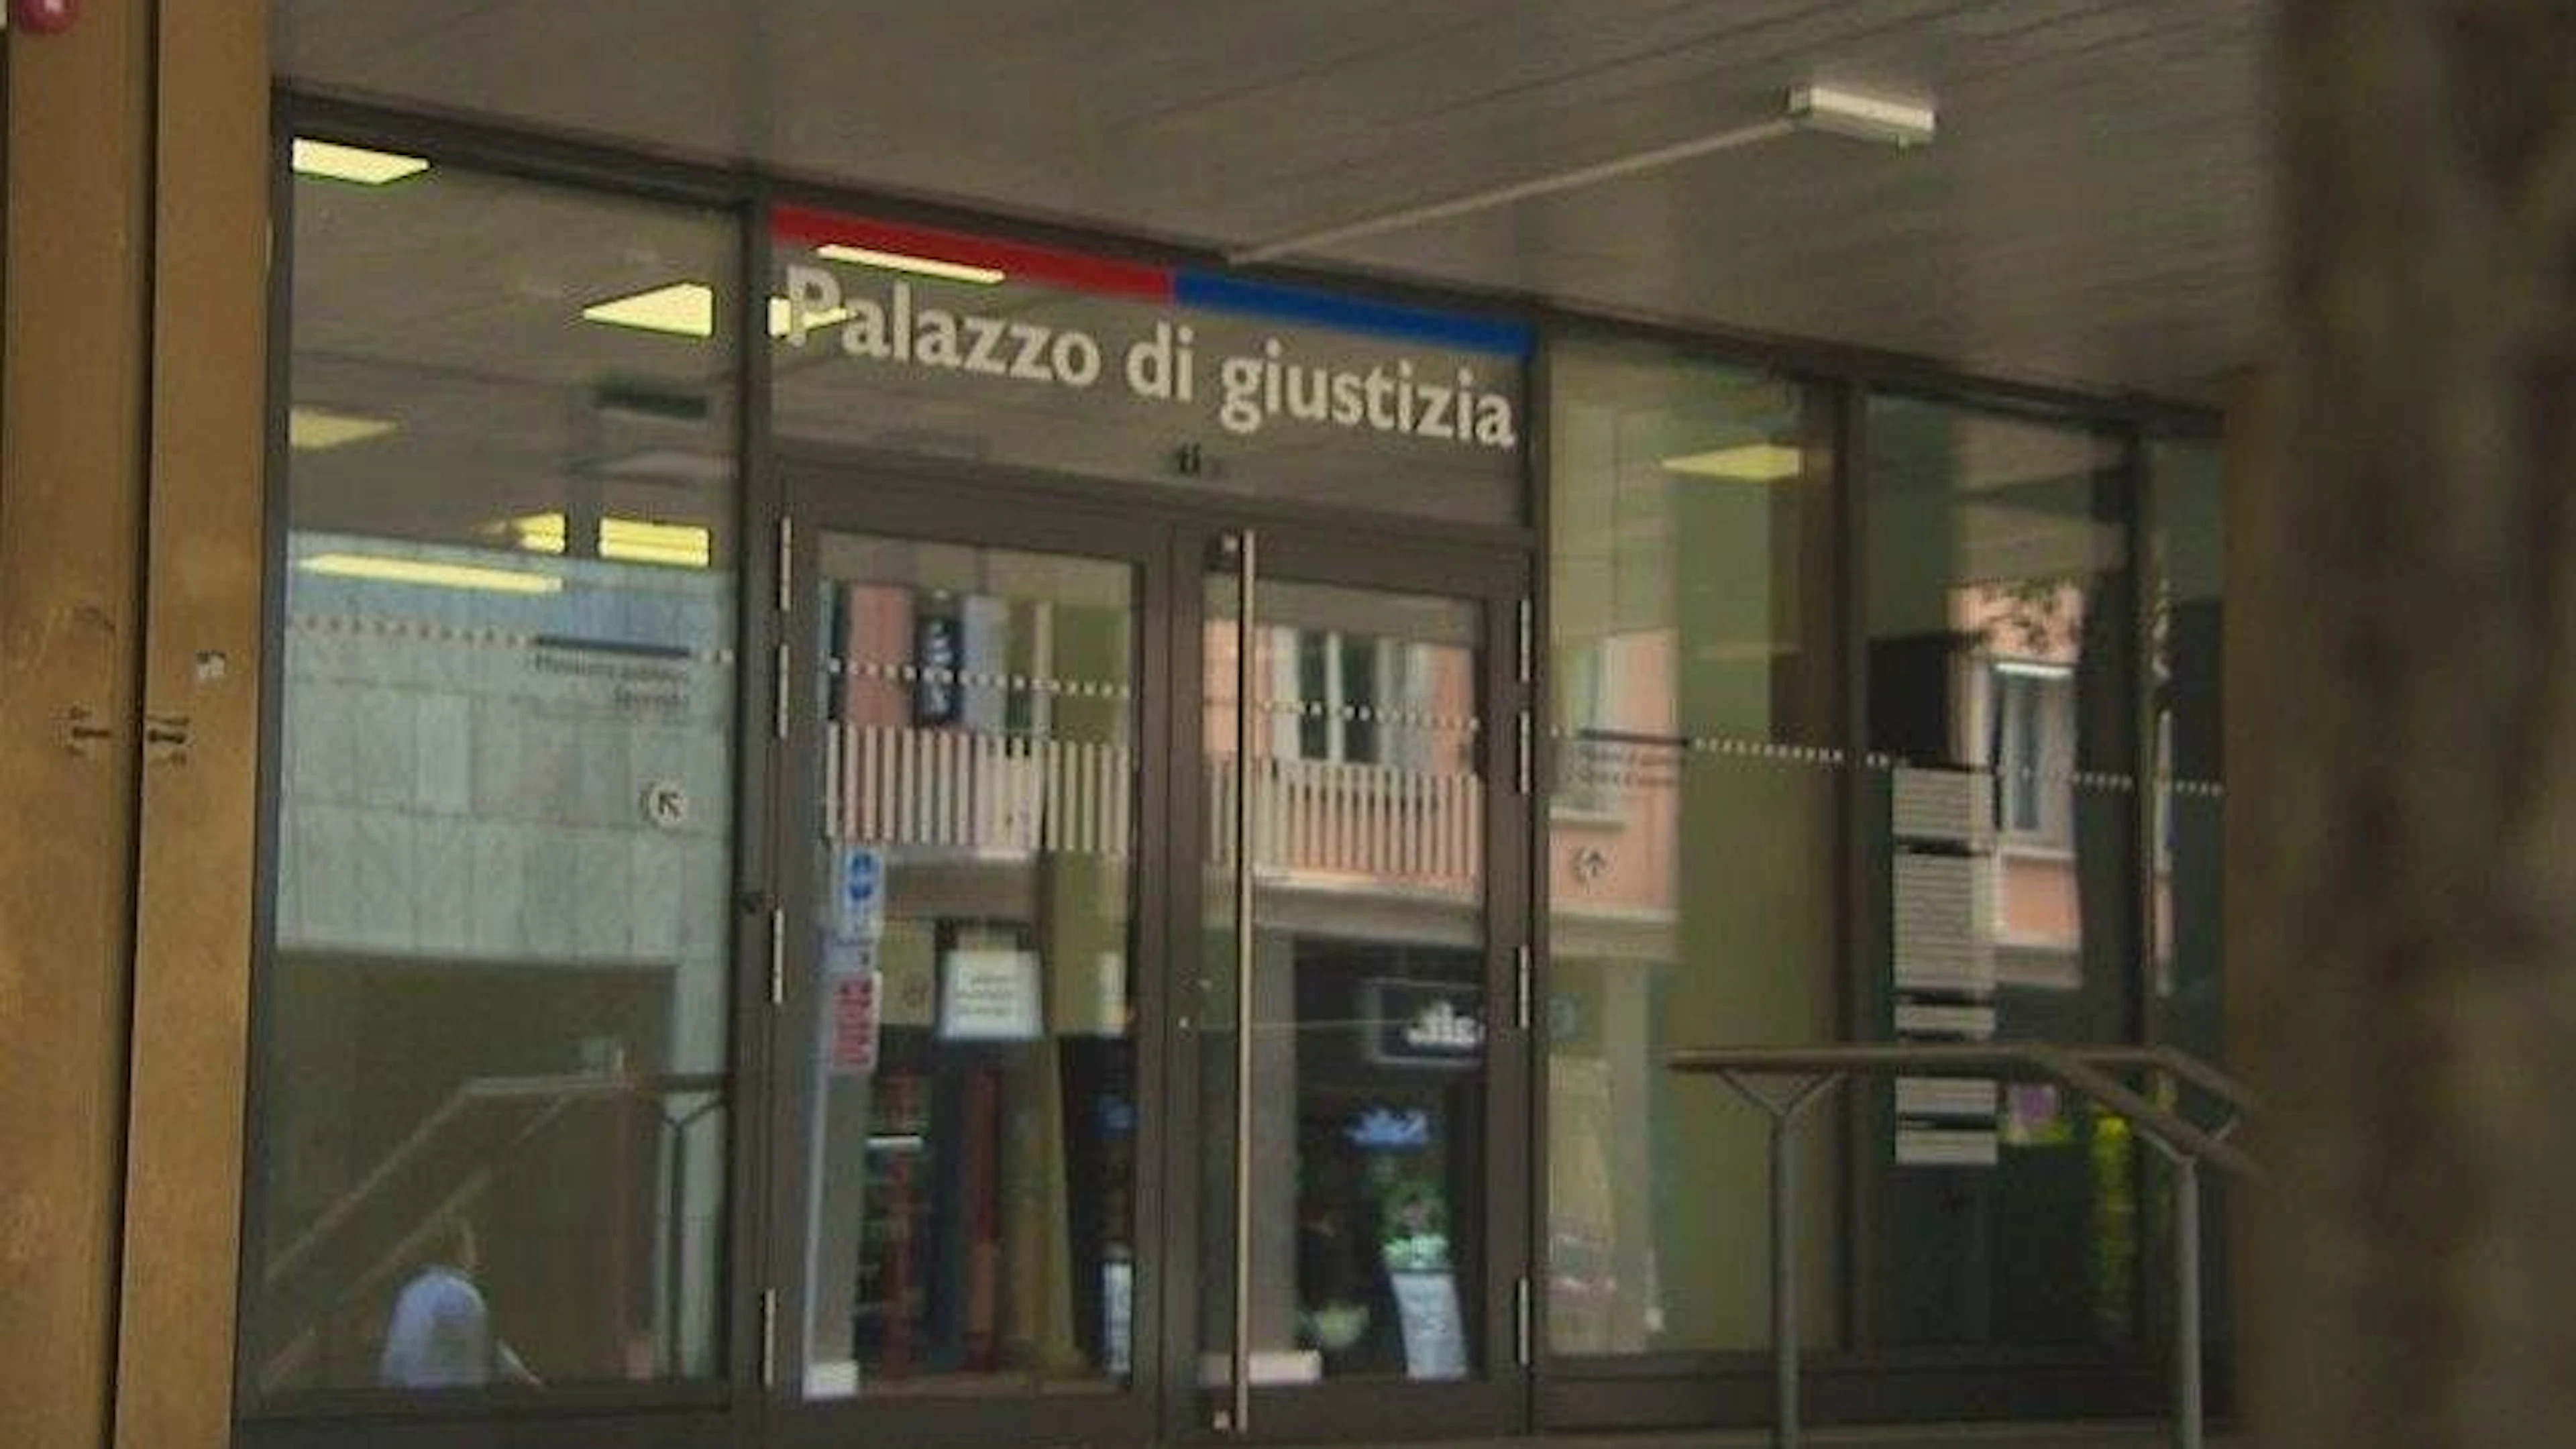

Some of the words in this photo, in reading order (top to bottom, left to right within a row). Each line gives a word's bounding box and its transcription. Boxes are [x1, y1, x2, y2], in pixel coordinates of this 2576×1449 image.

[787, 264, 1100, 387] Palazzo
[1127, 321, 1195, 402] di
[1219, 339, 1517, 449] giustizia
